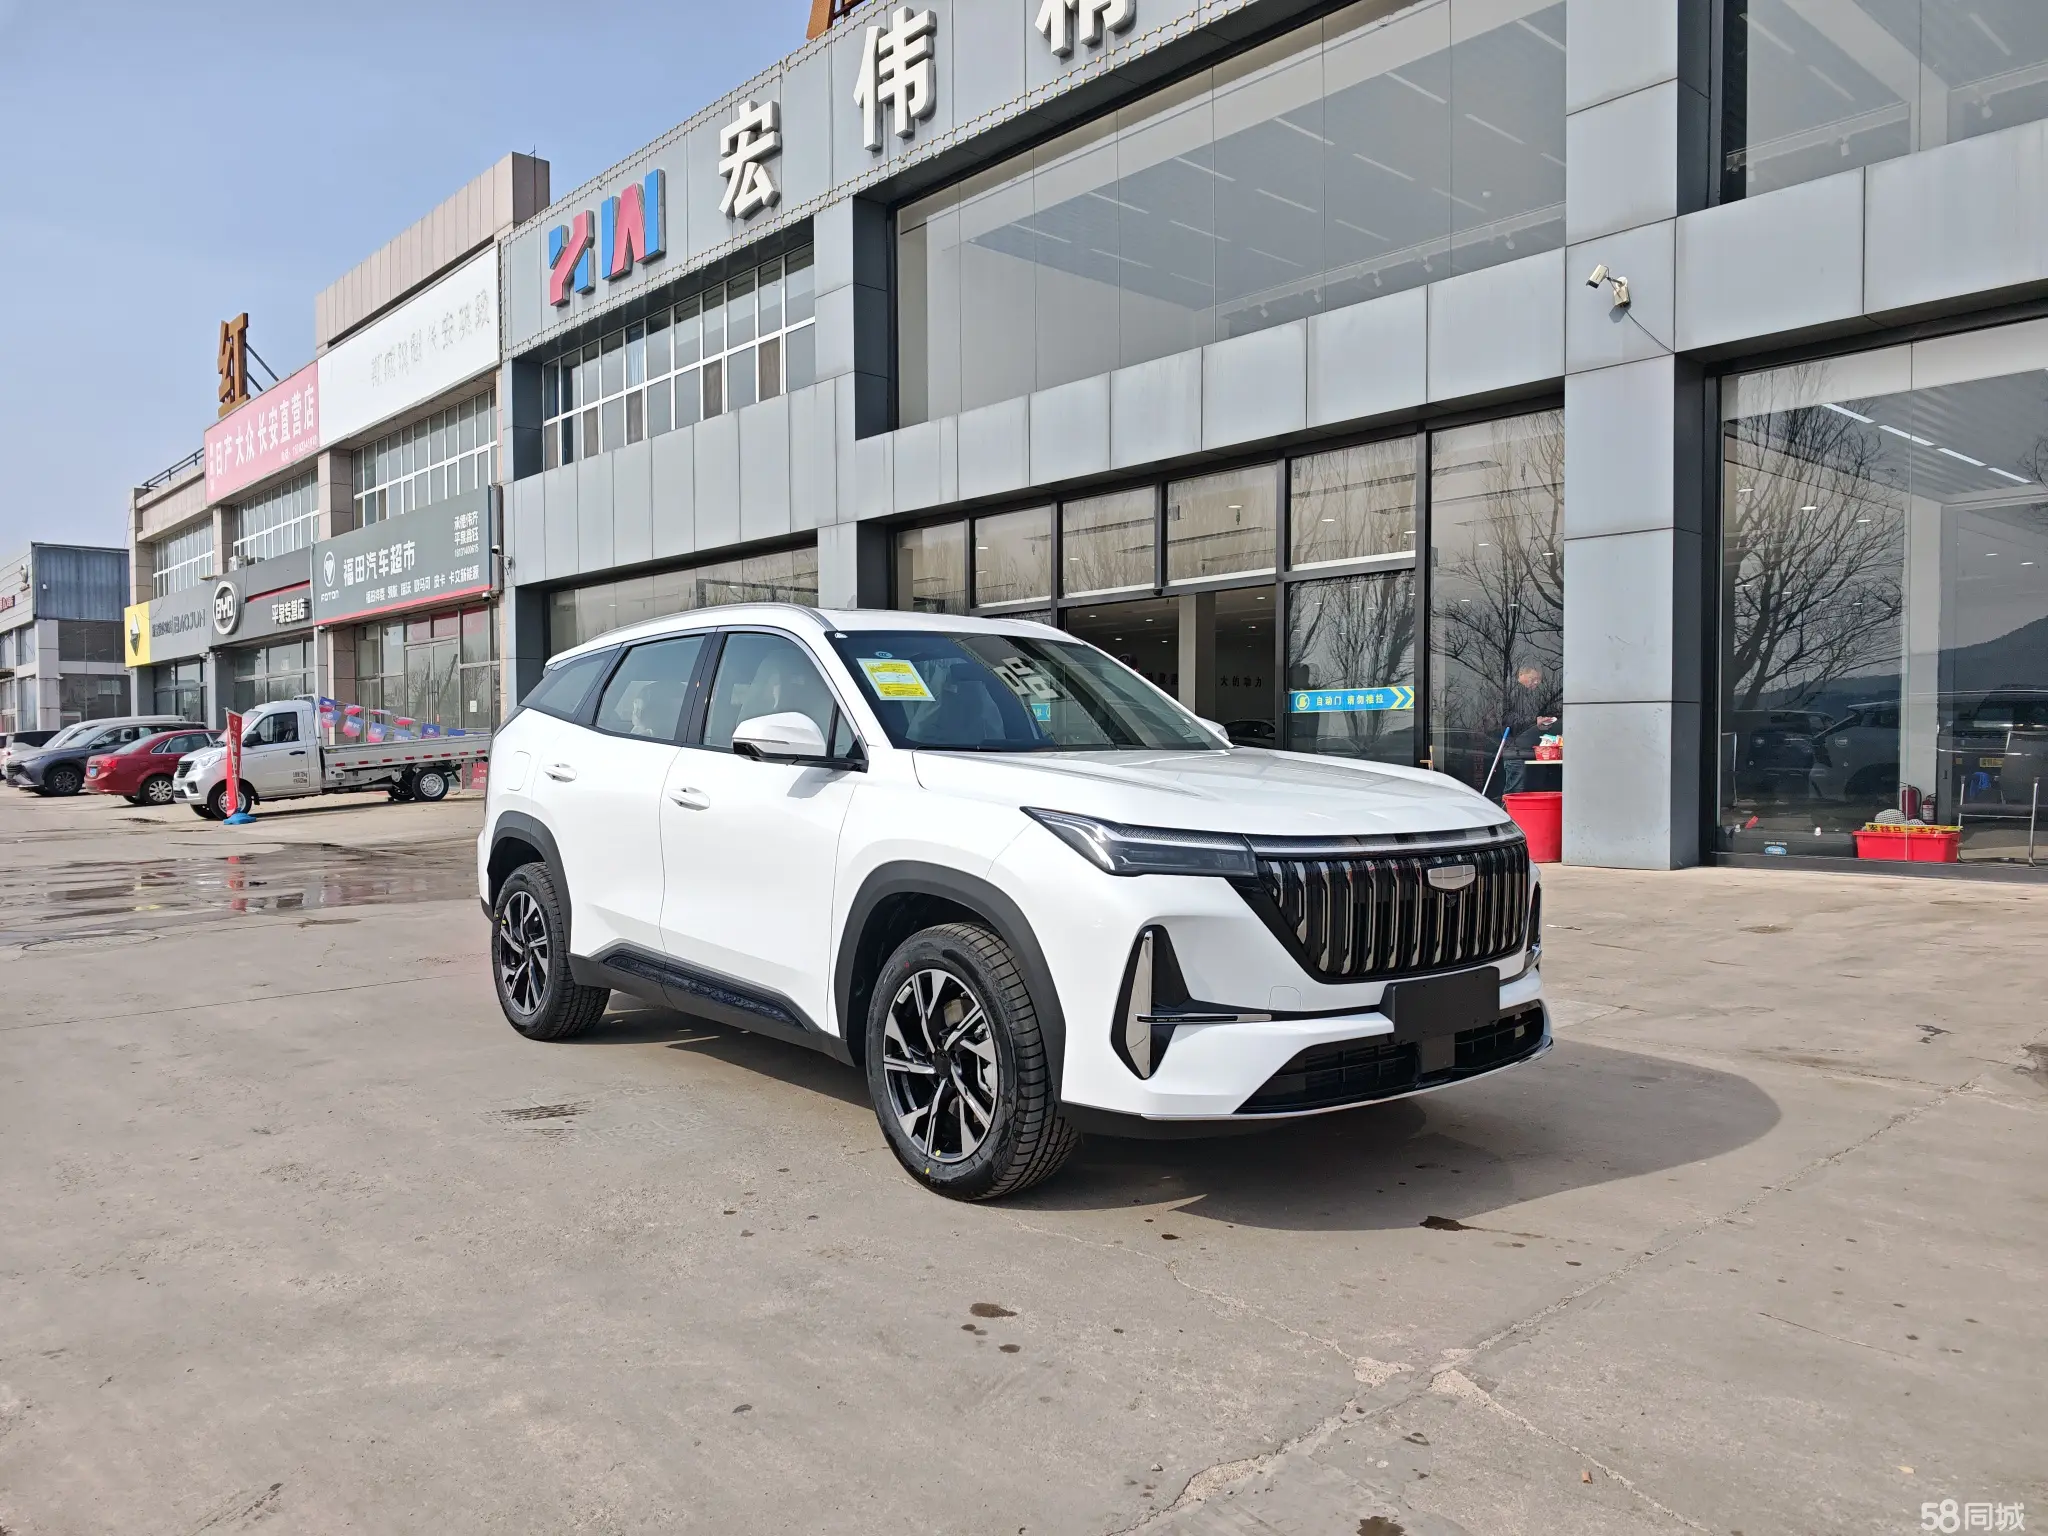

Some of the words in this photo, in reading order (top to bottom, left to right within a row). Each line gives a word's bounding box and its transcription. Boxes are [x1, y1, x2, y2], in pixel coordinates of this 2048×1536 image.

[216, 434, 232, 477] 日产
[236, 419, 255, 466] 大众
[257, 383, 315, 455] 长安直营店
[343, 540, 416, 588] 福田汽车超市
[216, 596, 233, 620] BYD
[271, 598, 306, 625] 平泉专营店
[1316, 695, 1342, 707] 自动门
[1347, 693, 1385, 706] 请勿推拉
